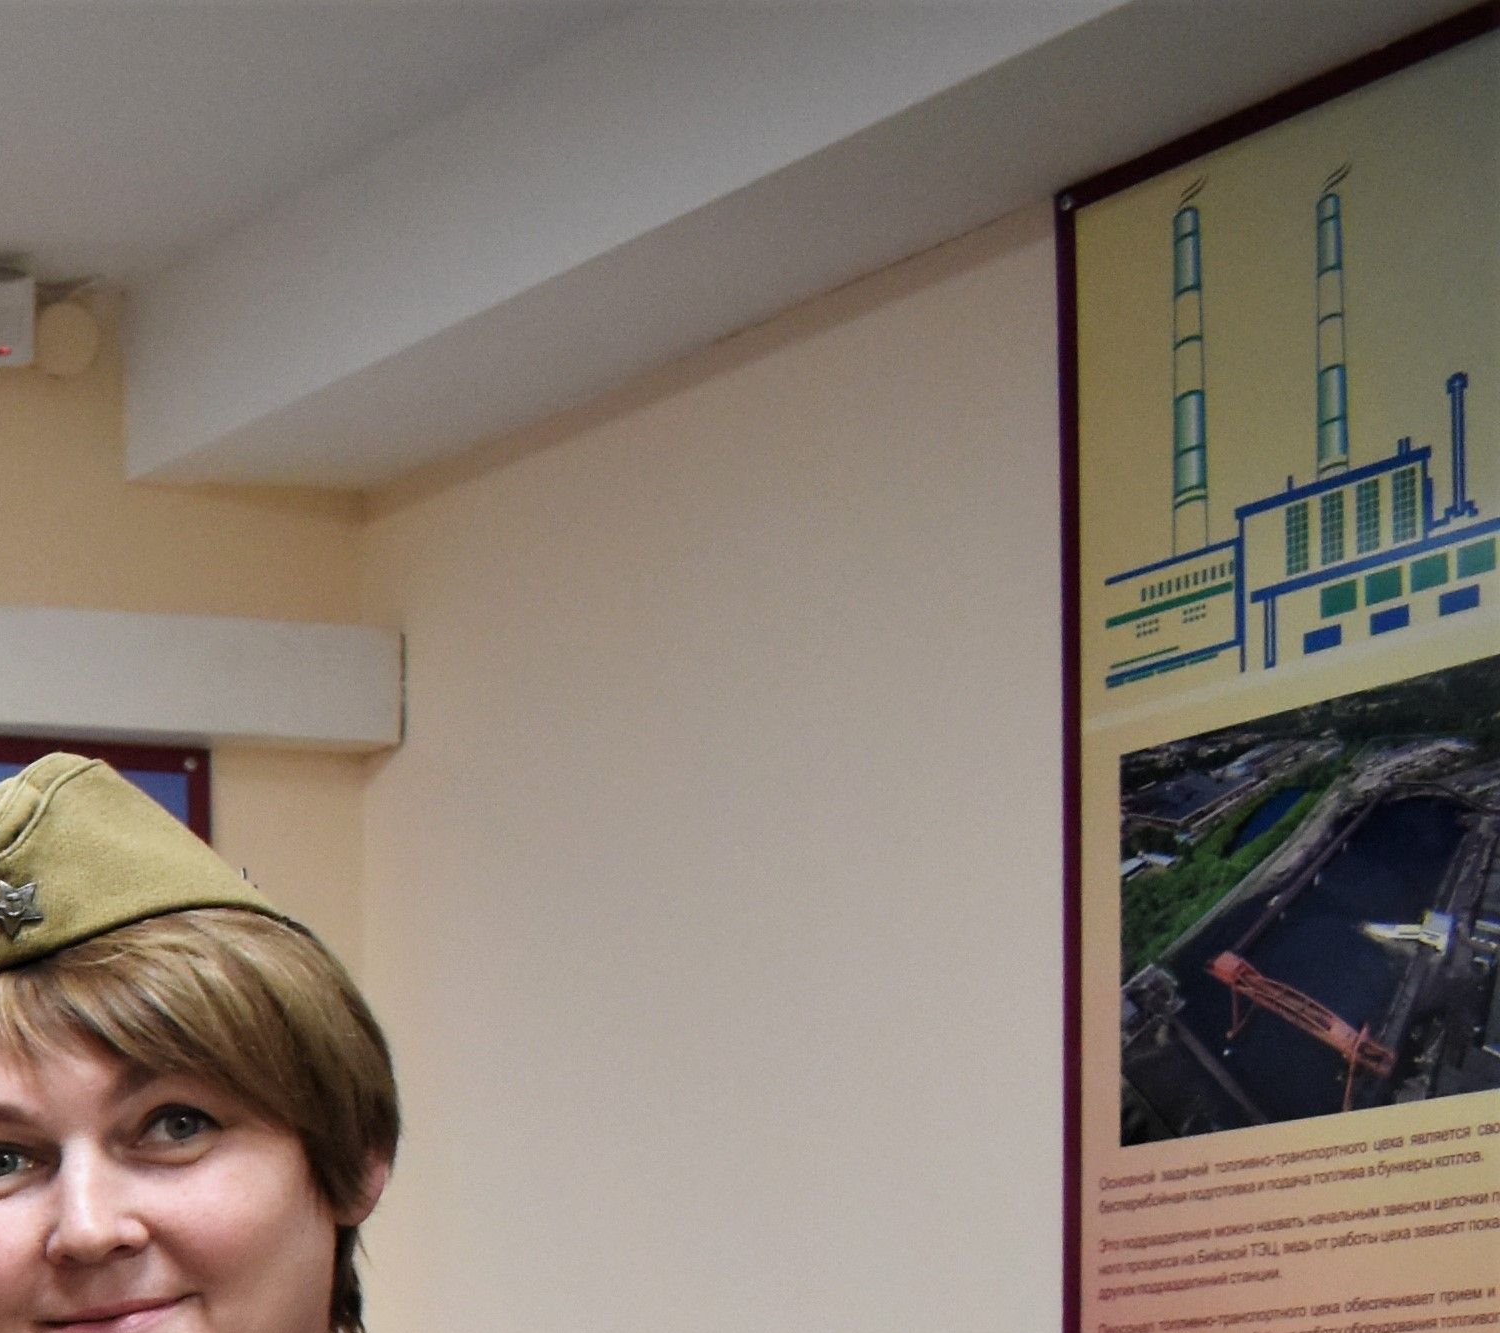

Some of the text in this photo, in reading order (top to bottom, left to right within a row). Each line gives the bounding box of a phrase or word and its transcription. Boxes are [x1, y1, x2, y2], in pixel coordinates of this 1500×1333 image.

[1373, 1136, 1404, 1151] цеха
[1410, 1126, 1471, 1145] является
[1376, 1160, 1432, 1178] бункеры
[1435, 1151, 1484, 1168] котлов.
[1434, 1192, 1489, 1210] цепочки
[1331, 1231, 1378, 1249] работы
[1380, 1228, 1411, 1243] цеха
[1414, 1221, 1465, 1239] зависят
[1440, 1288, 1482, 1305] прием
